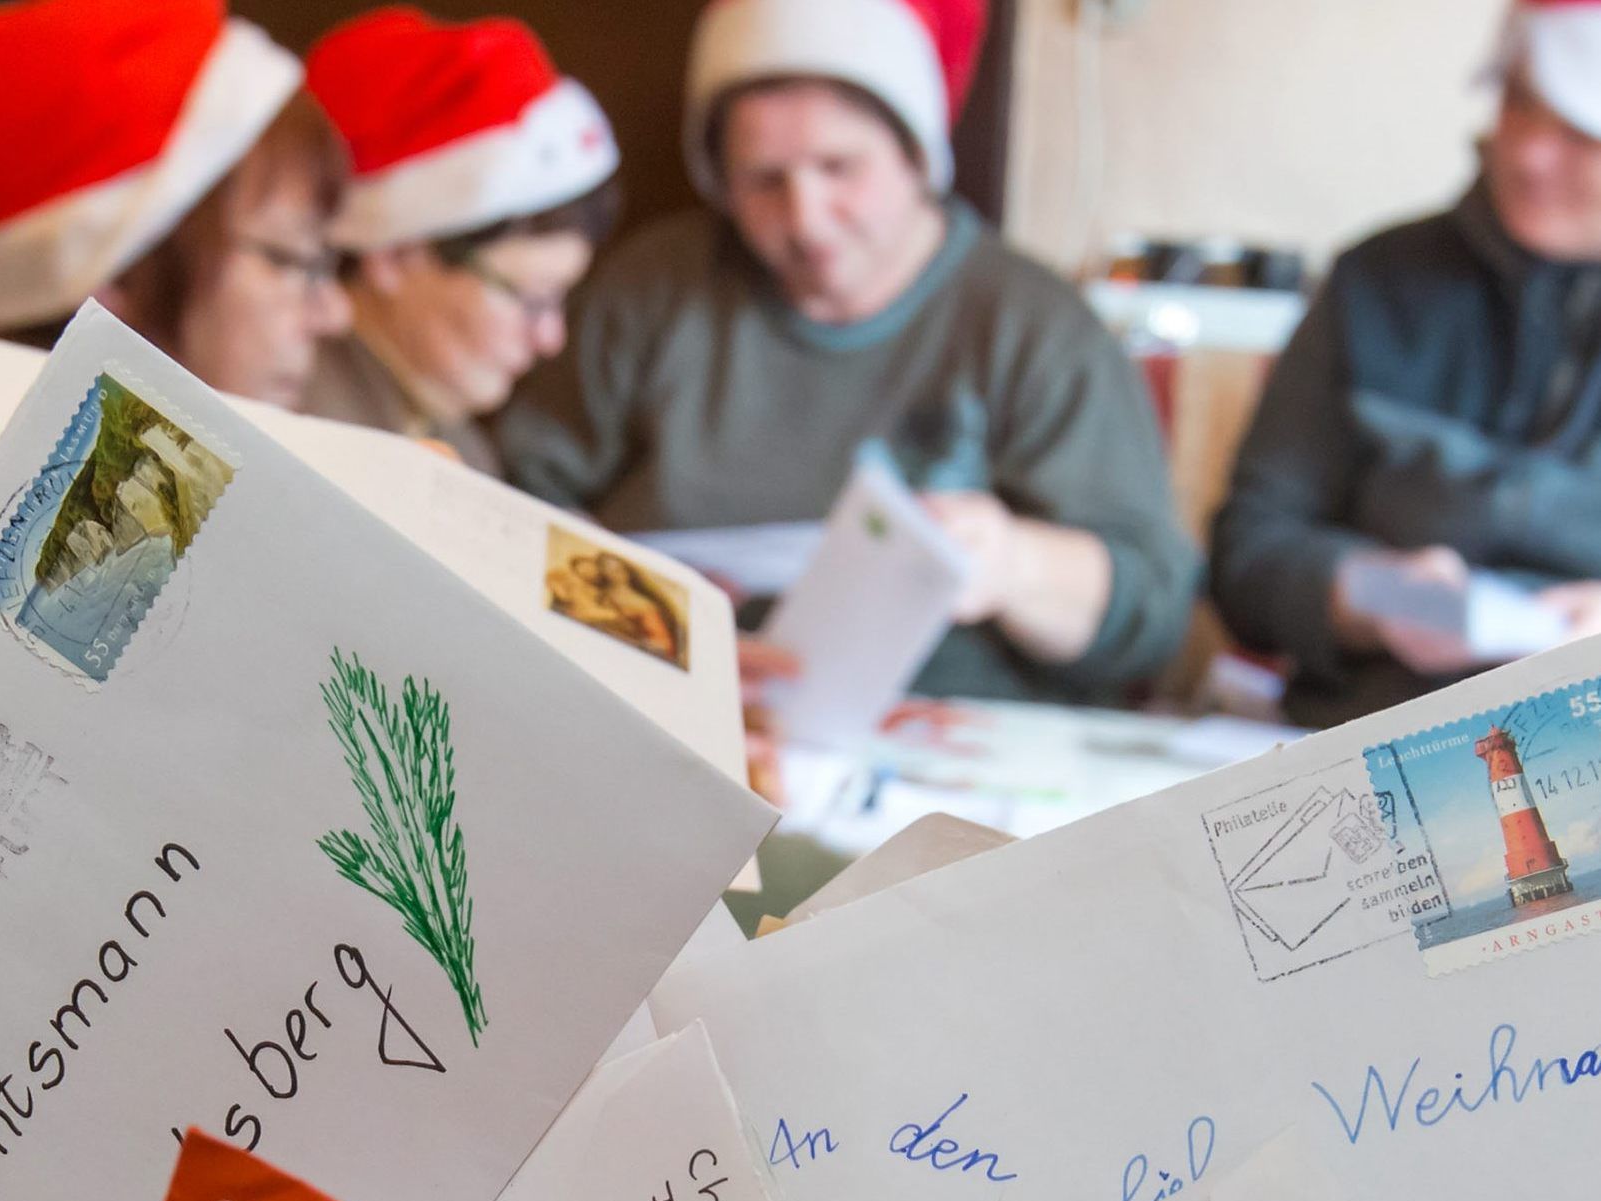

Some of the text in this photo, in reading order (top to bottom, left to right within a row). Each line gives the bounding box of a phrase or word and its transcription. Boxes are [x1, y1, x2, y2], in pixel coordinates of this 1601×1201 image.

[83, 637, 110, 668] 55
[1568, 690, 1601, 718] 55
[1213, 799, 1288, 838] Philatelie
[770, 1117, 840, 1169] An
[889, 1092, 1018, 1182] den
